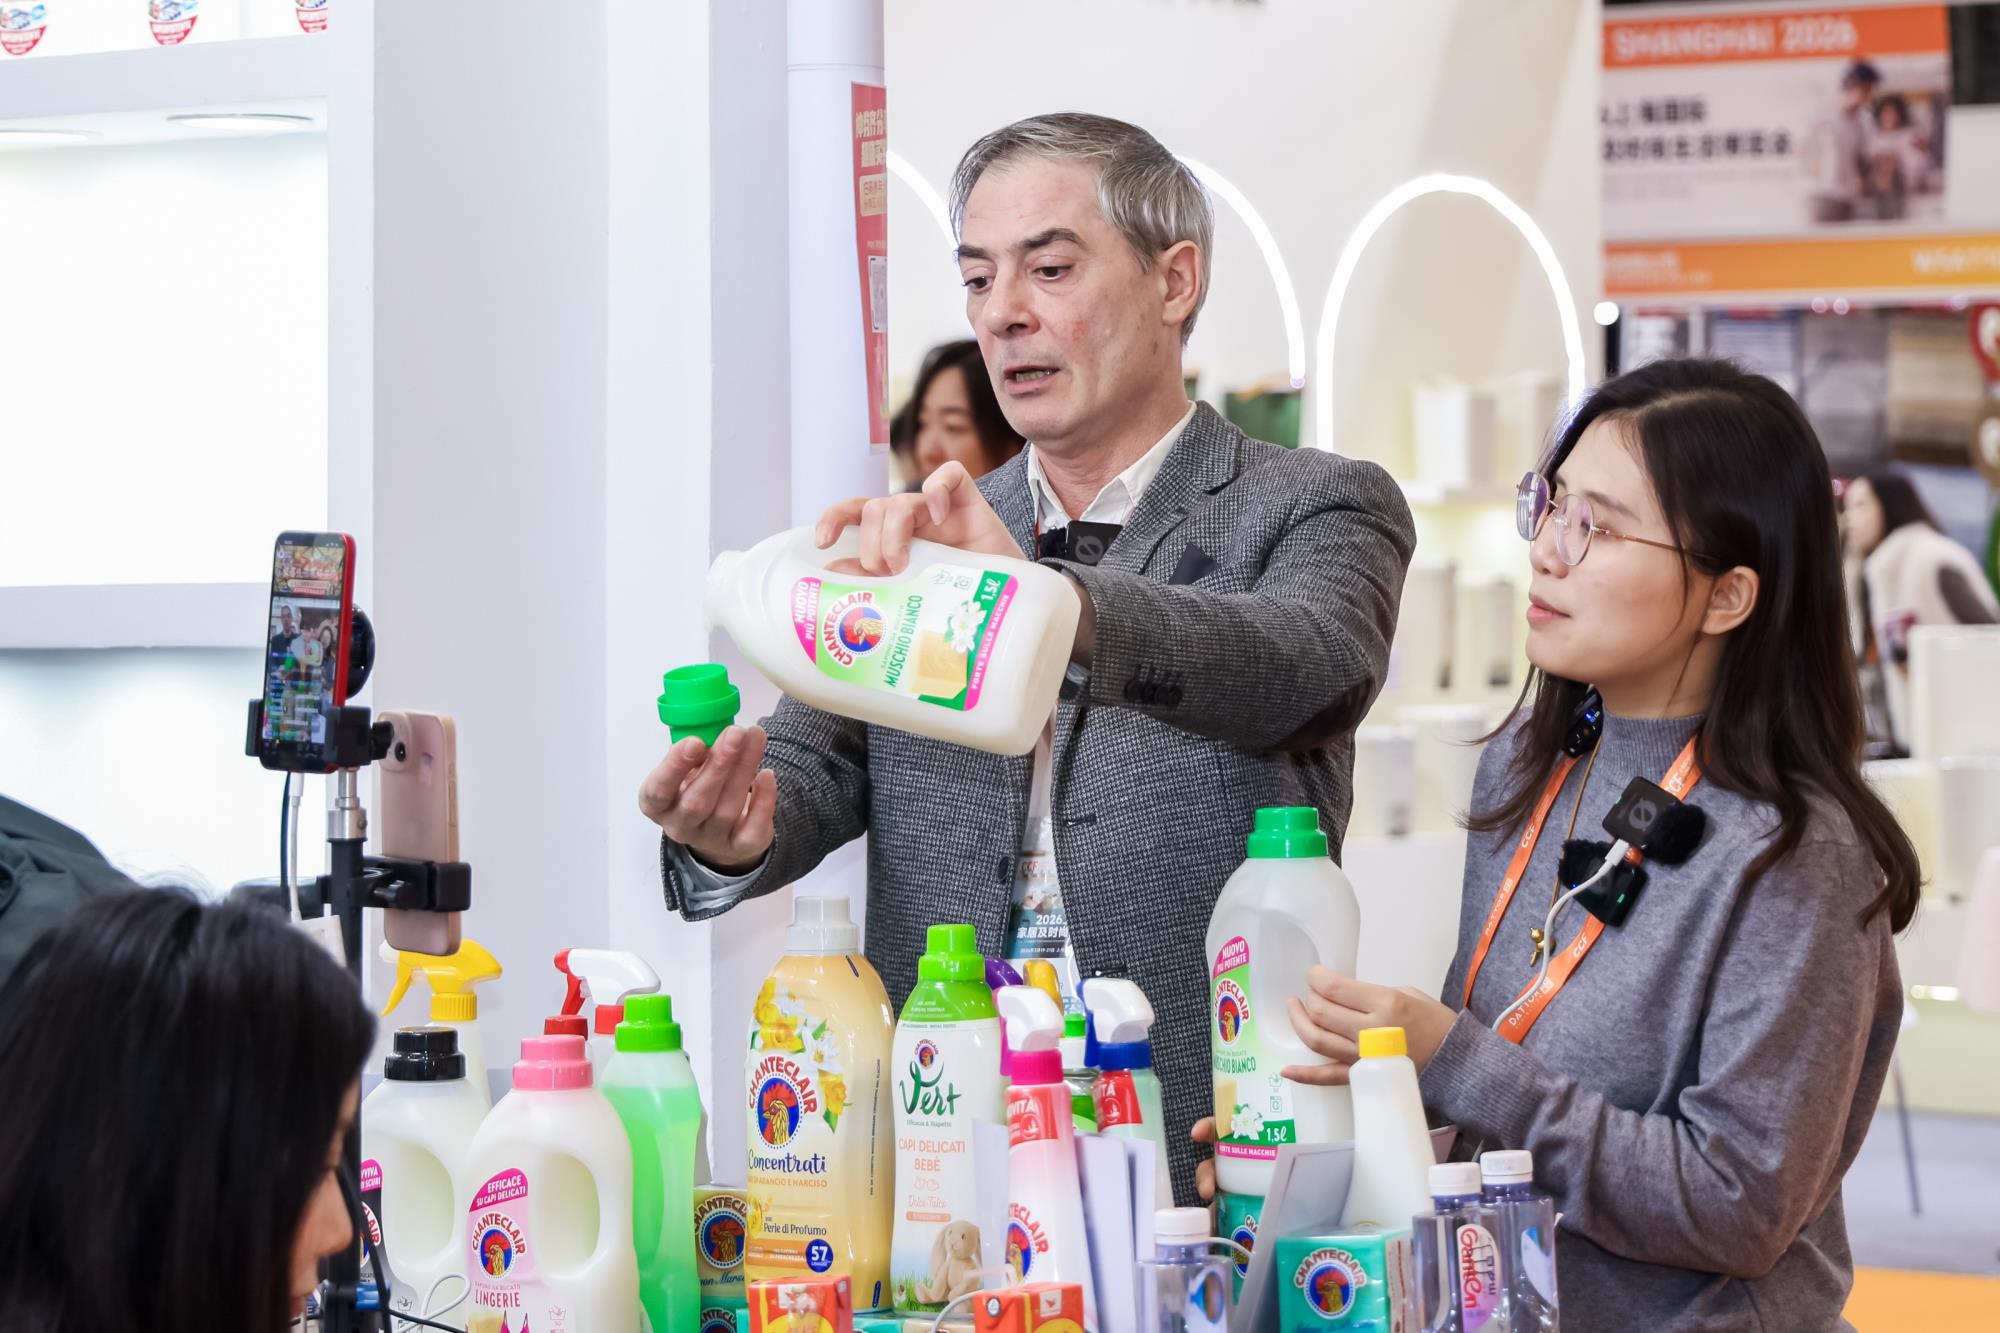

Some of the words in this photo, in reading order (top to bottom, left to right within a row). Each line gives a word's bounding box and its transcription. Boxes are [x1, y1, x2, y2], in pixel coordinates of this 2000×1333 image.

[795, 581, 809, 623] NUOVO
[806, 582, 819, 621] POTENTE
[824, 592, 873, 666] CHANTECLAIR
[884, 636, 912, 688] MUSCHIO
[900, 595, 923, 635] BIANCO
[972, 661, 985, 689] FORTE
[990, 594, 1010, 631] MACCHIE
[1222, 941, 1245, 959] NUOVO
[1573, 933, 1588, 958] CCF
[1224, 953, 1247, 969] POTENTE
[1232, 1056, 1256, 1073] BIANCO
[749, 1056, 818, 1115] CHANTECLAIR
[899, 1060, 962, 1116] Vert
[898, 1138, 915, 1151] CAPI
[919, 1140, 966, 1153] DELICATI
[1248, 1149, 1276, 1157] MACCHIE
[748, 1149, 827, 1174] Concentrati
[487, 1175, 522, 1193] EFFICACE
[792, 1179, 828, 1188] NARCISO
[477, 1198, 484, 1207] SU
[484, 1194, 497, 1206] CAPI
[498, 1186, 526, 1201] DELICATI
[472, 1213, 526, 1255] CHANTECLAIR
[763, 1222, 780, 1233] Perle
[782, 1223, 789, 1234] di
[790, 1224, 827, 1236] Profumo
[1008, 1203, 1049, 1254] TECLAIR
[811, 1246, 829, 1261] 57
[1296, 1249, 1365, 1286] CHANTECLAIR
[475, 1289, 520, 1308] LINGERIE
